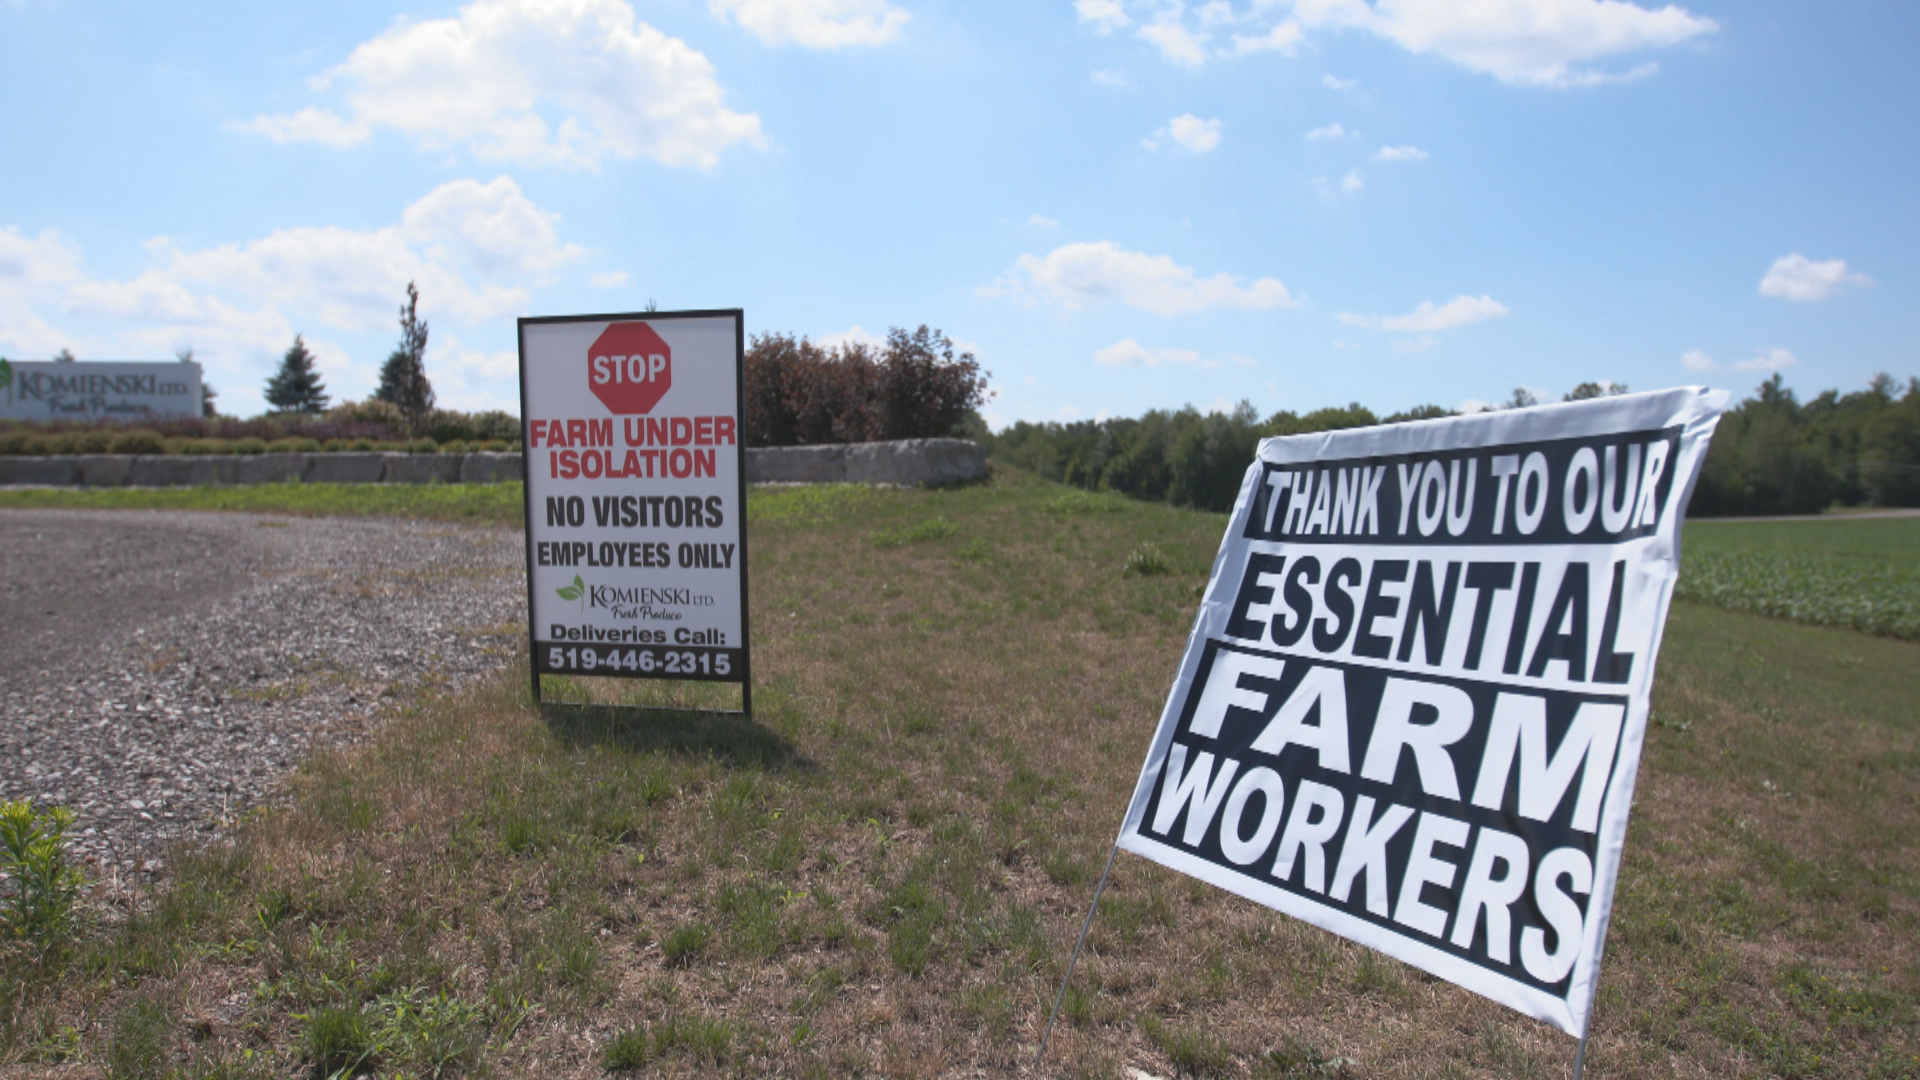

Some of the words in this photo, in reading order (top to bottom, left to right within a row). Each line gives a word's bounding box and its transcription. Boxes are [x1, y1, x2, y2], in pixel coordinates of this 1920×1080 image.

[593, 354, 666, 384] STOP
[19, 372, 156, 399] KOMIENSKI
[530, 418, 613, 448] FARM
[624, 416, 736, 446] UNDER
[550, 448, 716, 479] ISOLATION
[1263, 466, 1387, 536] THANK
[1397, 457, 1478, 537] YOU
[1491, 451, 1549, 536] TO
[1563, 440, 1670, 535] OUR
[546, 496, 585, 528] NO
[592, 496, 724, 528] VISITORS
[537, 541, 671, 568] EMPLOYEES
[678, 543, 736, 569] ONLY
[589, 584, 690, 608] KOMIENSKI
[693, 595, 715, 606] LTD.
[611, 604, 638, 620] Fresh
[640, 605, 682, 621] Produce
[1224, 552, 1636, 684] ESSENTIAL
[550, 624, 667, 643] Deliveries
[674, 627, 726, 645] Call:
[549, 647, 731, 675] 519-446-2315
[1188, 647, 1626, 834] FARM
[1151, 742, 1594, 984] WORKERS
